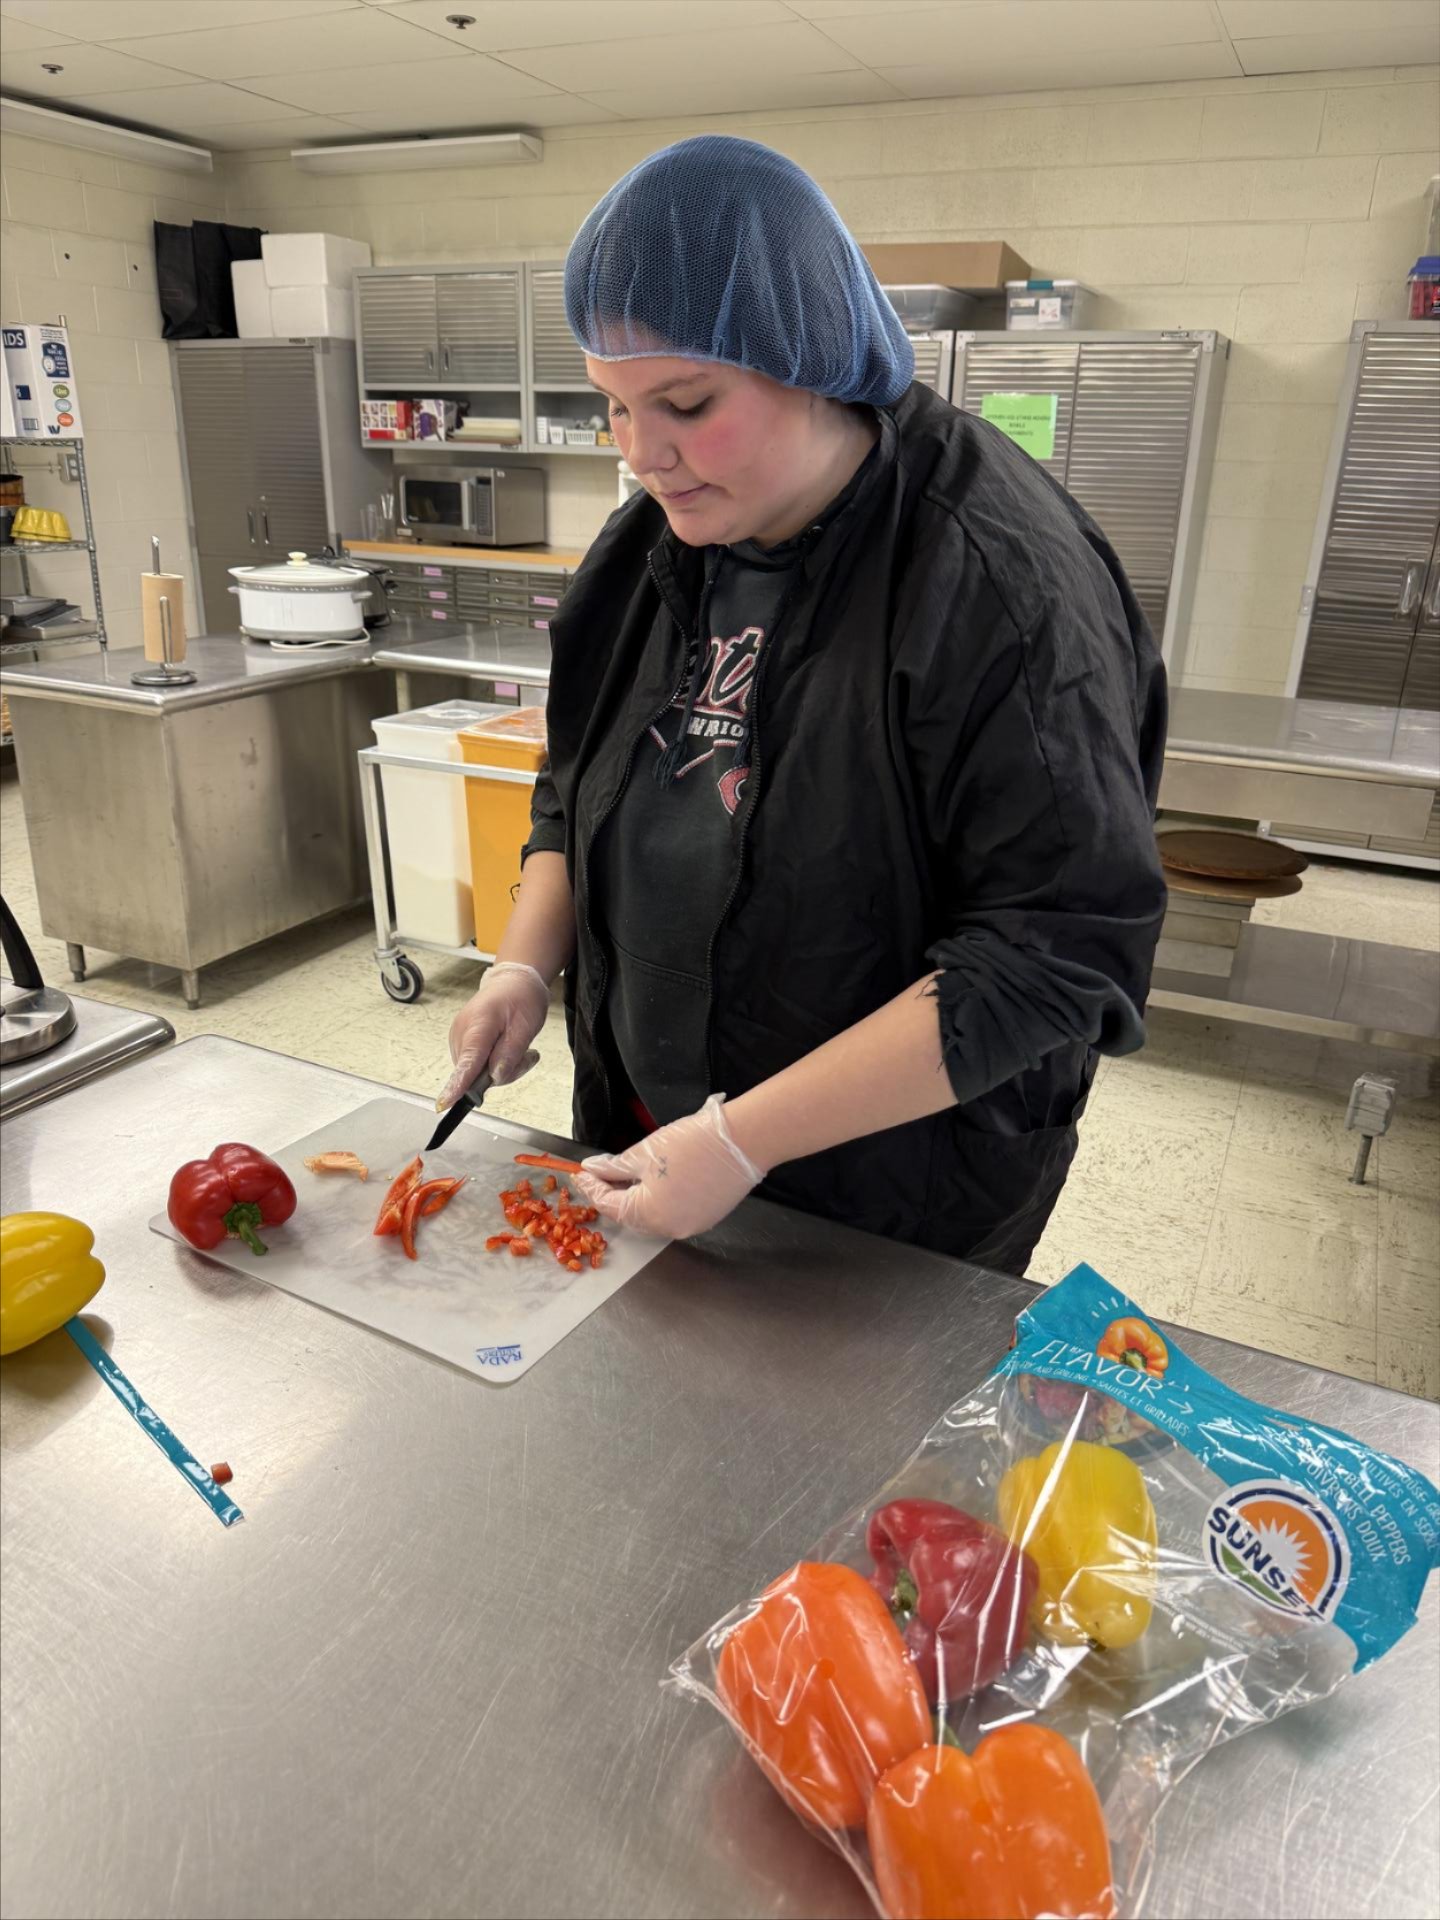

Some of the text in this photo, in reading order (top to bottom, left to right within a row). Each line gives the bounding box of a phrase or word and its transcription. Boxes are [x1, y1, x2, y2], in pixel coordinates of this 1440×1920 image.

[476, 1349, 522, 1366] RADA
[1031, 1339, 1164, 1400] FLAVOR
[1400, 1498, 1419, 1518] EN
[1355, 1520, 1388, 1563] DOUX
[1369, 1503, 1412, 1566] PEPPERS
[1207, 1506, 1326, 1623] SUNSET
